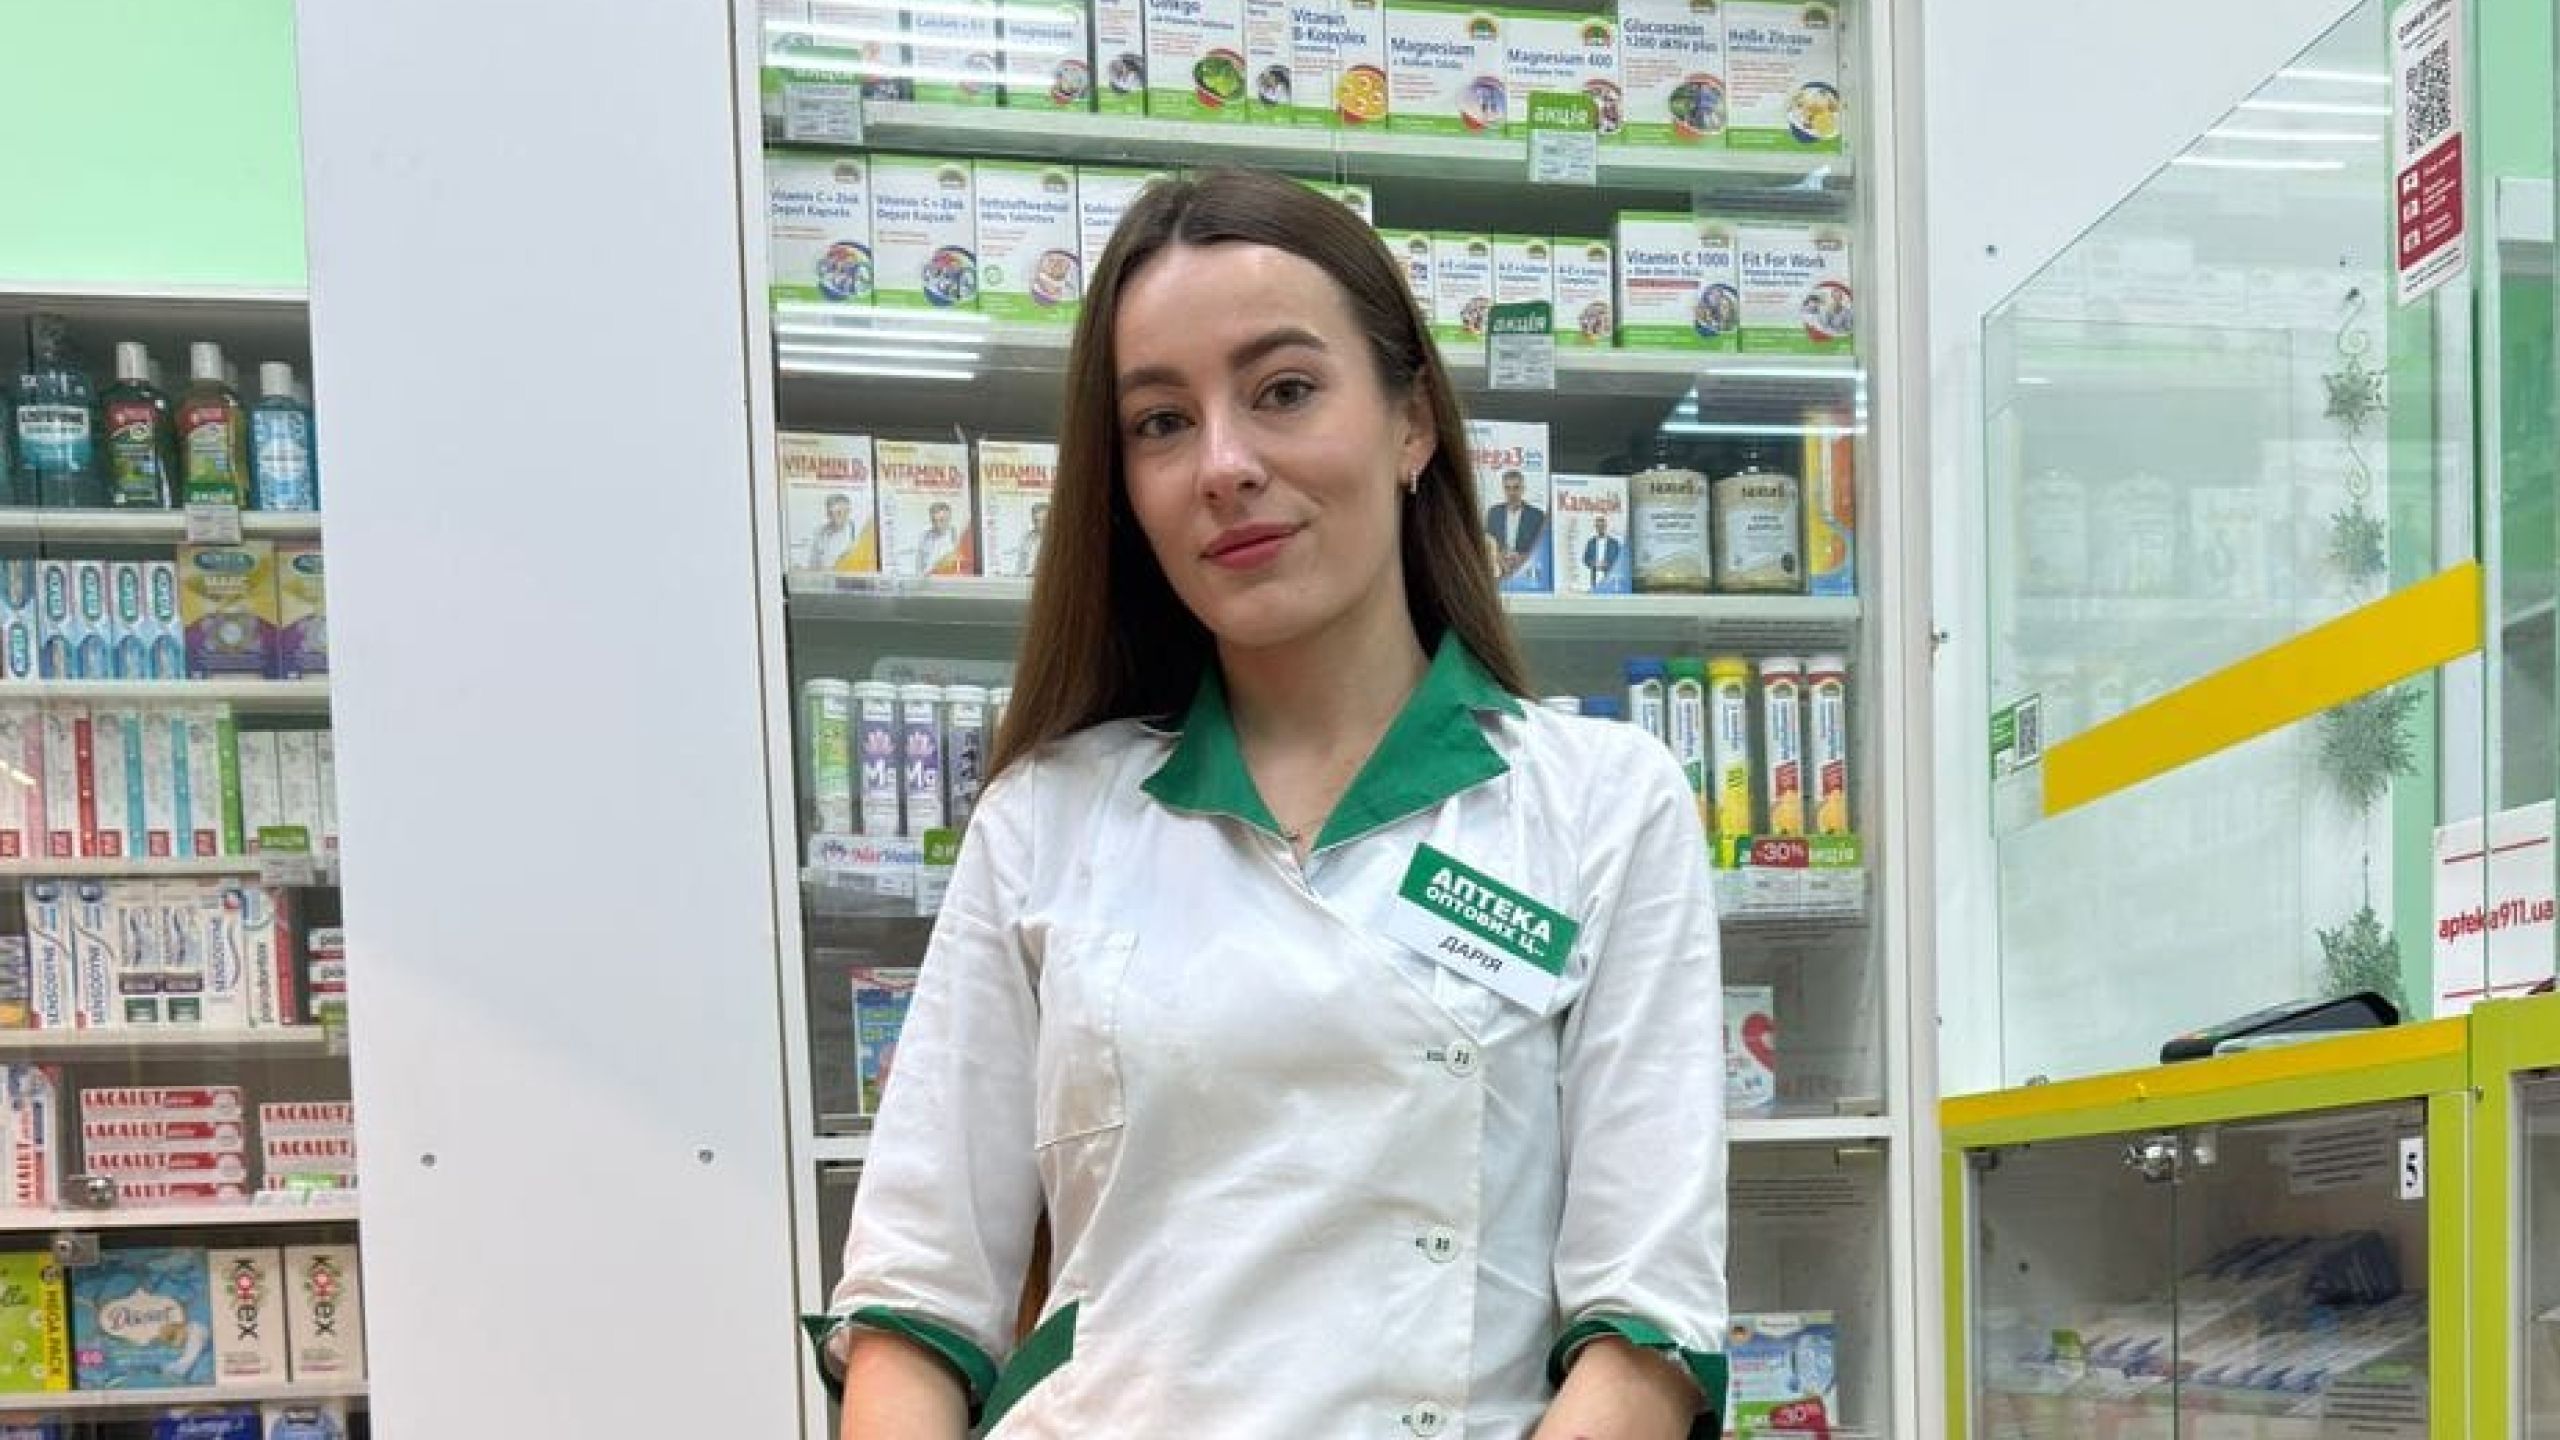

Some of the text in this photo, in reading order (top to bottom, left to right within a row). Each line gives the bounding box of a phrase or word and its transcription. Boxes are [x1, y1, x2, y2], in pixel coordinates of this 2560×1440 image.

[1624, 18, 1704, 36] Glucosamin
[1626, 35, 1655, 49] 1200
[1692, 40, 1718, 54] plus
[1769, 29, 1813, 45] Zitrone
[1391, 37, 1475, 58] Magnesium
[1507, 48, 1613, 69] Magnesium 400
[1533, 104, 1589, 127] акція
[1625, 250, 1730, 268] Vitamin C 1000
[1742, 251, 1826, 268] Fit For Work
[784, 453, 848, 475] VITAMIN
[880, 462, 947, 482] VITAMIN
[982, 463, 1047, 482] VITAMIN
[1426, 886, 1515, 940] ОПТОВИХ
[1431, 866, 1551, 943] АПТЕКА
[2438, 898, 2554, 945] apteka911.ua
[1437, 936, 1503, 973] ДАРІЯ
[85, 1090, 162, 1106] LACALUT
[265, 1106, 345, 1122] LACALUT
[86, 1122, 163, 1139] LACALUT
[268, 1140, 347, 1156] LACALUT
[88, 1152, 166, 1170] LACALUT
[2405, 1152, 2418, 1189] 5
[46, 1290, 62, 1376] MEGA PACK
